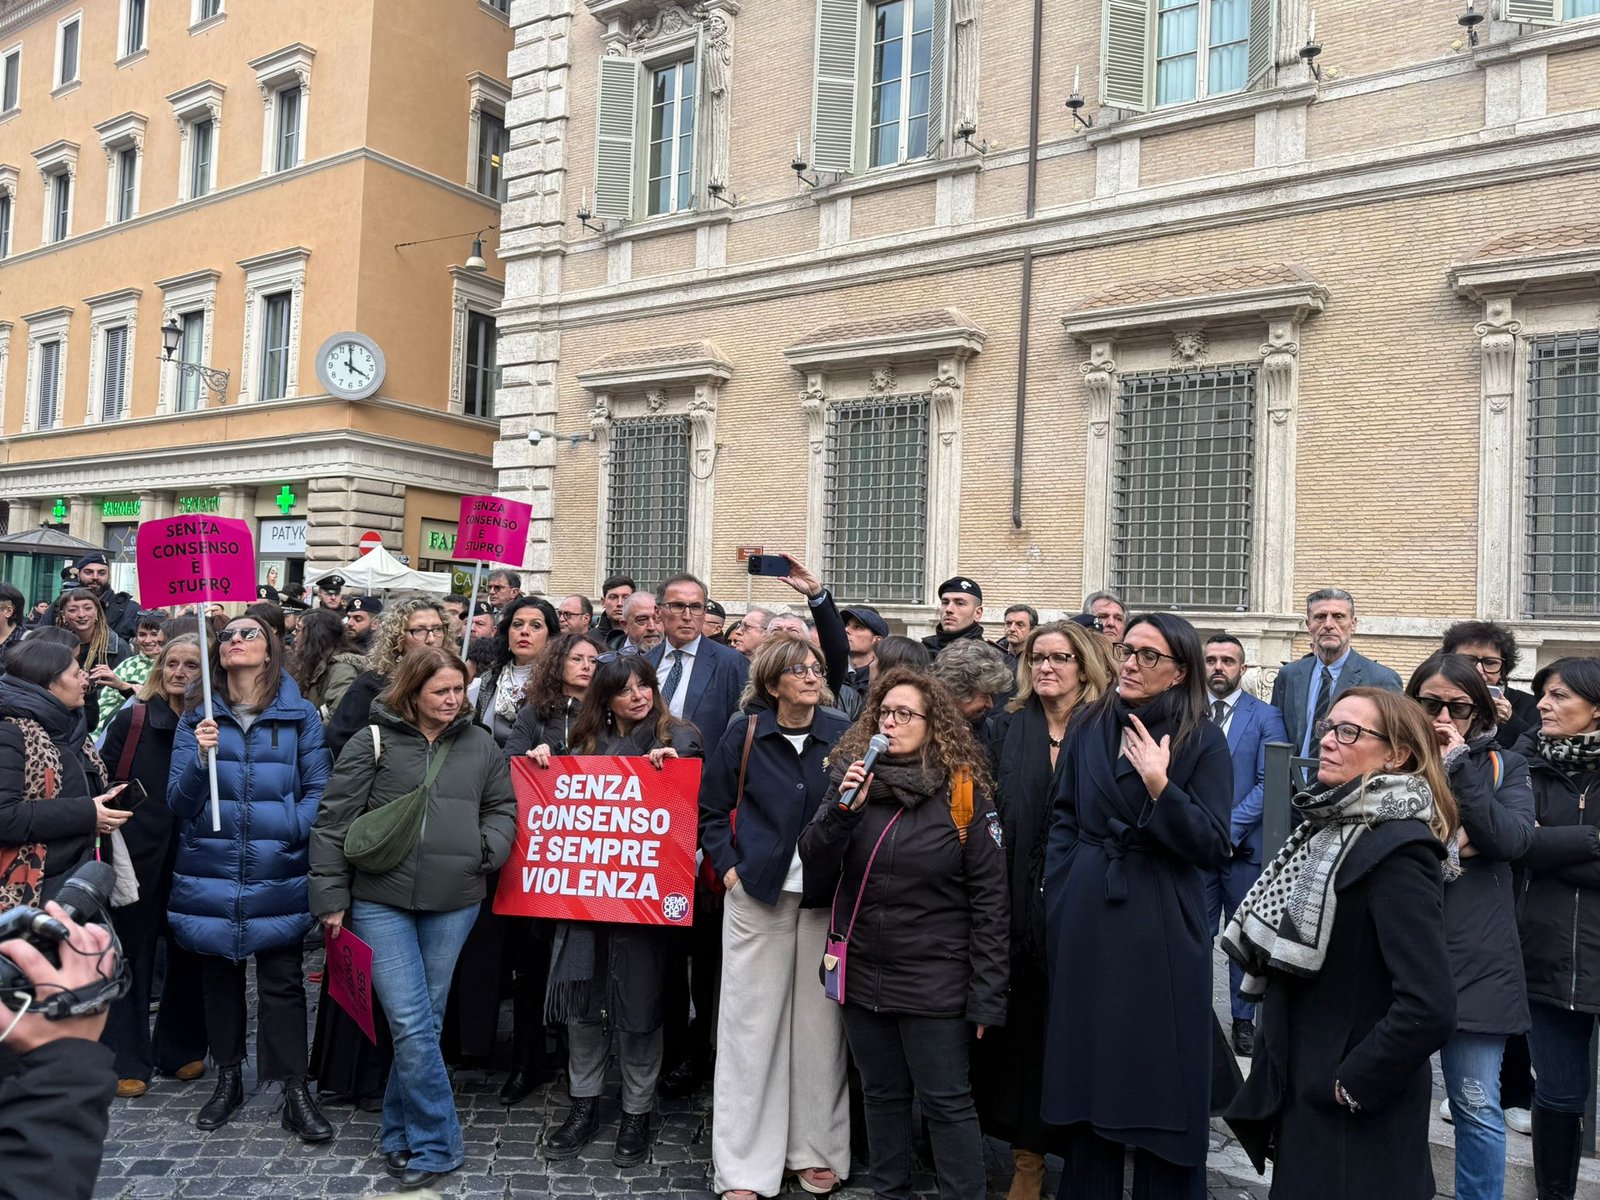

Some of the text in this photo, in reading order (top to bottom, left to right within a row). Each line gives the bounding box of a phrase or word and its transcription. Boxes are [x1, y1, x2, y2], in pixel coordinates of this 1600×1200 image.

[473, 501, 506, 514] SENZA
[166, 522, 220, 538] SENZA
[465, 515, 518, 530] CONSENSO
[272, 526, 307, 540] PATYK
[152, 541, 240, 558] CONSENSO
[465, 541, 504, 558] STUPRO
[191, 558, 200, 574] È
[168, 577, 231, 595] STUPRO
[554, 774, 642, 801] SENZA
[527, 804, 671, 835] CONSENSO
[526, 830, 661, 868] È SEMPRE
[522, 866, 660, 901] VIOLENZA
